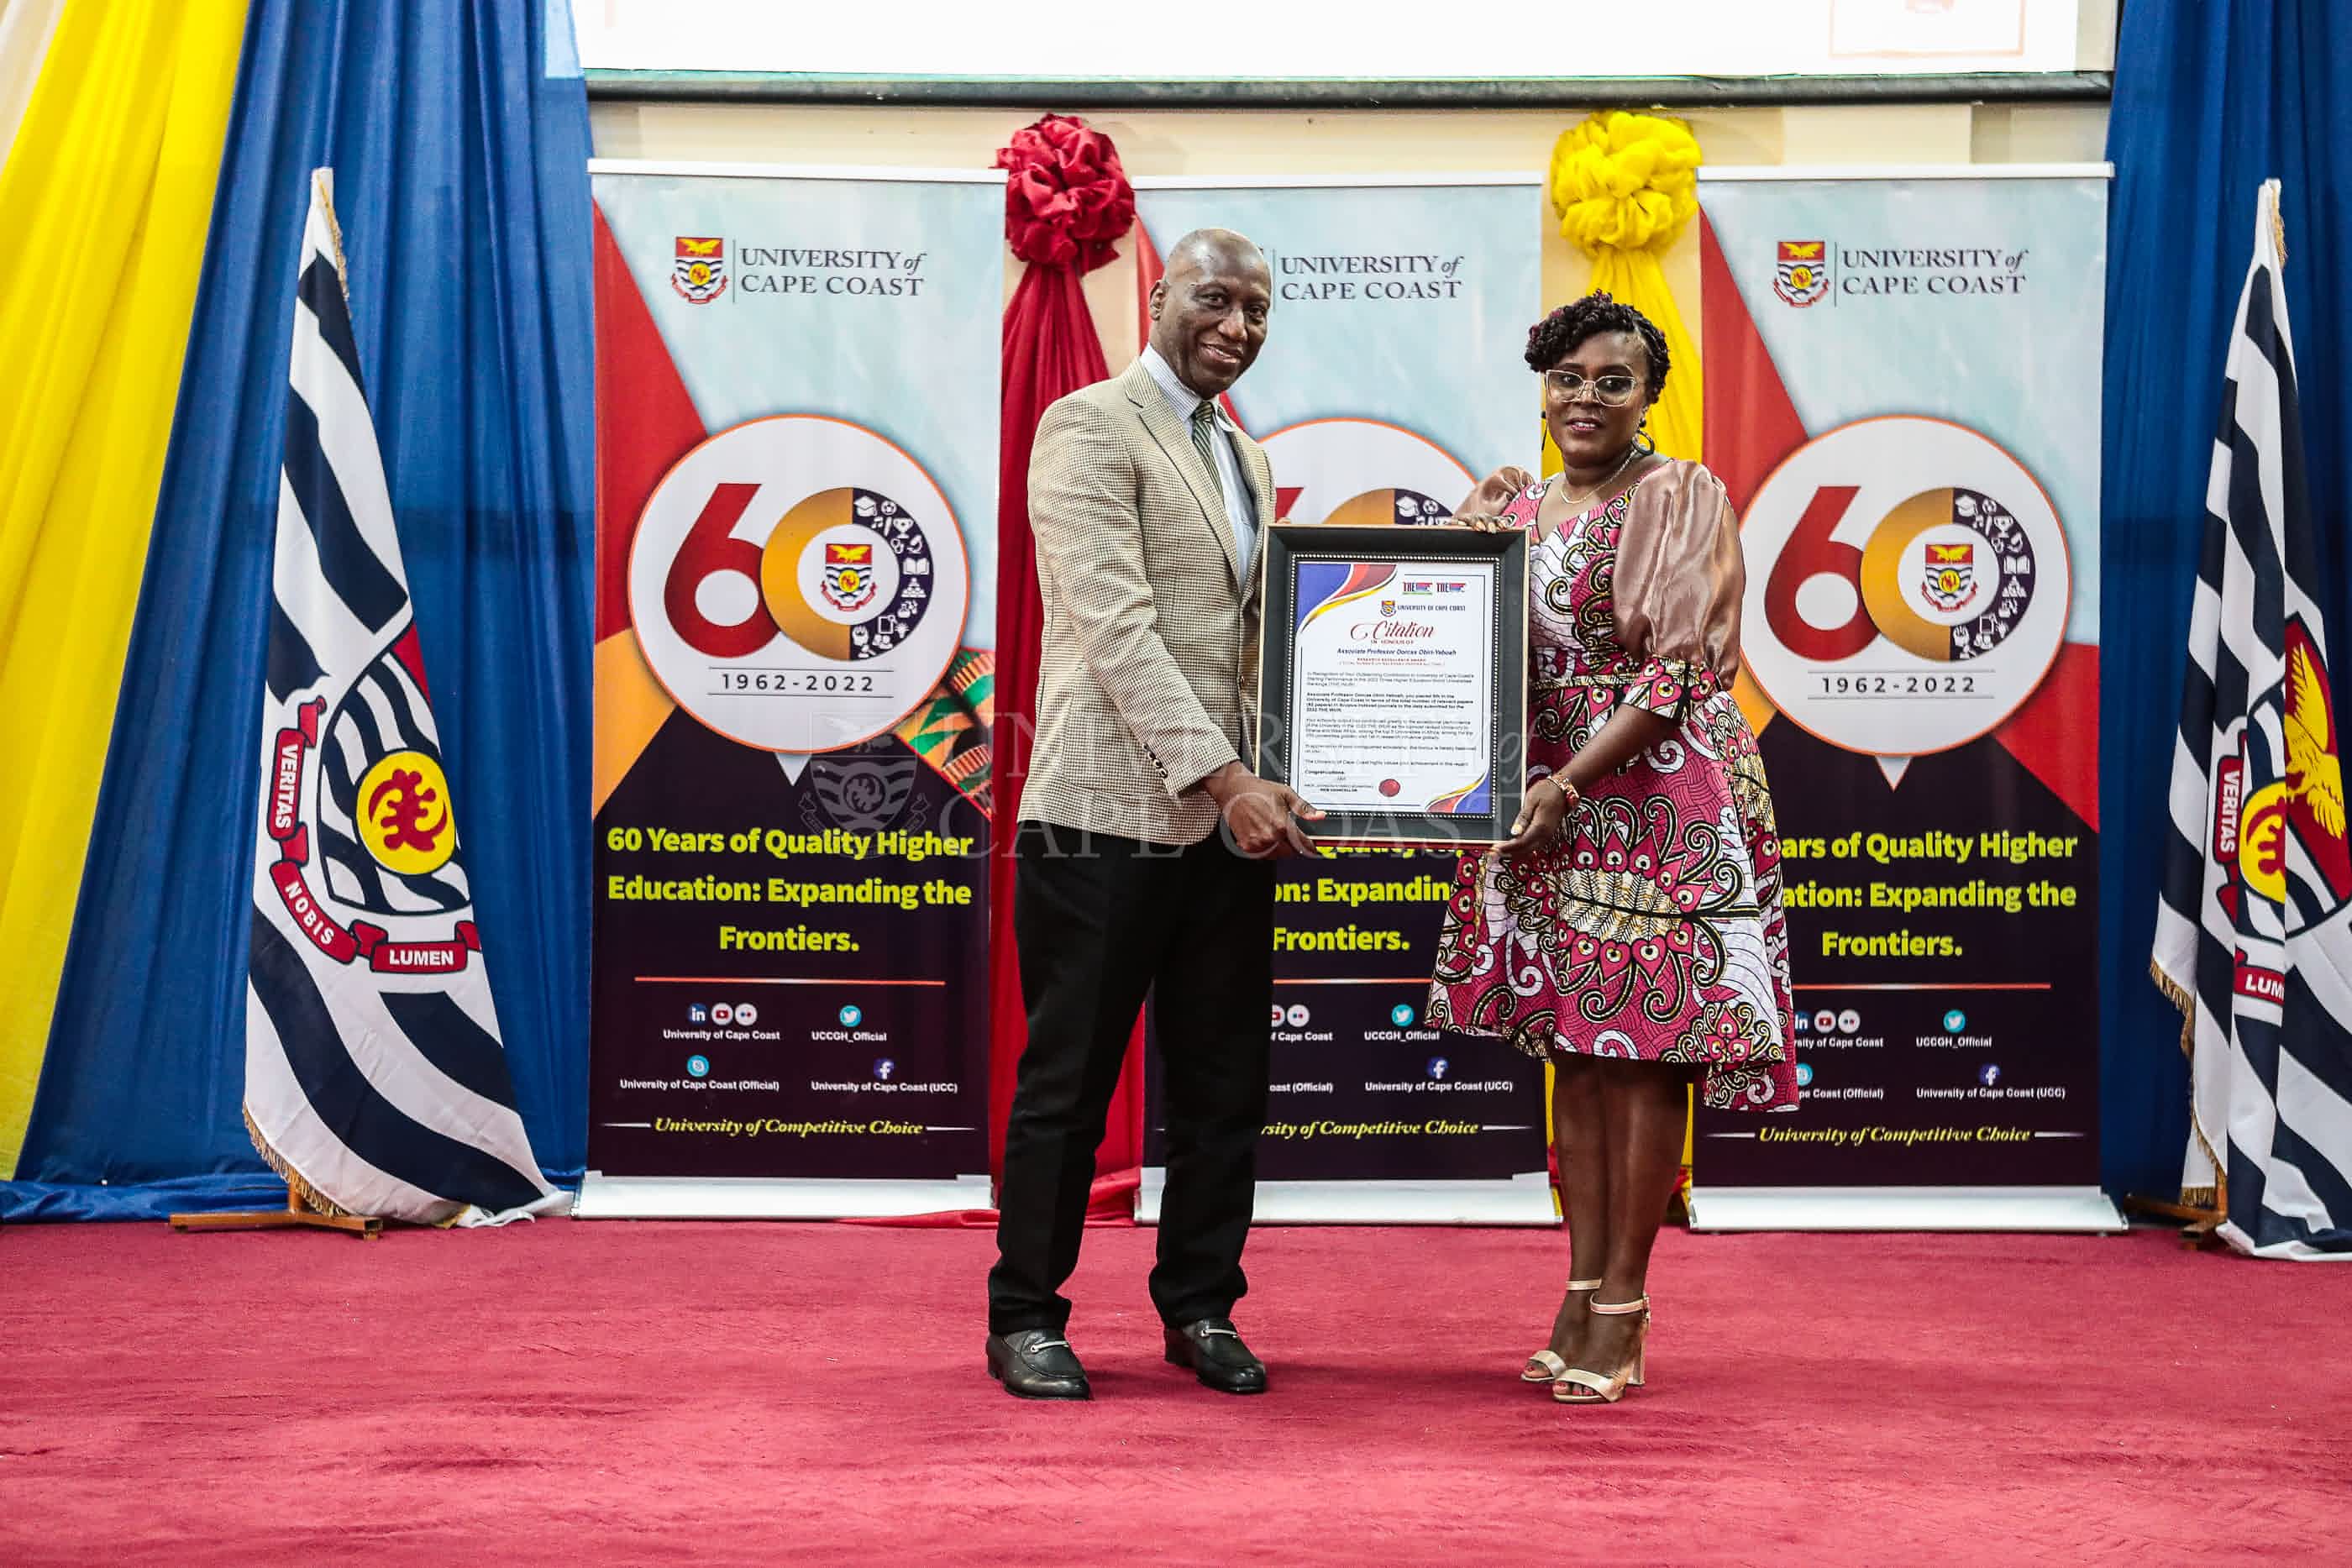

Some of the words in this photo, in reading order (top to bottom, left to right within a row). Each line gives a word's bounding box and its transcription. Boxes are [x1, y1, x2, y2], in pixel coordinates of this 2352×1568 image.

[740, 249, 900, 269] UNIVERSITY
[904, 254, 927, 275] of
[1281, 256, 1438, 275] UNIVERSITY
[1441, 256, 1464, 278] of
[1843, 249, 2001, 268] UNIVERSITY
[2005, 249, 2029, 273] of
[741, 275, 816, 293] CAPE
[827, 277, 924, 296] COAST
[1281, 283, 1356, 300] CAPE
[1365, 281, 1462, 299] COAST
[1843, 276, 1918, 294] CAPE
[1927, 275, 2026, 294] COAST
[664, 483, 934, 661] 60
[1765, 485, 2036, 663] 60
[1351, 620, 1434, 639] Citation
[722, 673, 874, 692] 1962-2022
[1823, 675, 1976, 694] 1962-2022
[276, 744, 299, 829] VERITAS
[2220, 770, 2240, 853] VERITAS
[608, 828, 642, 851] 60
[648, 828, 724, 852] Years
[730, 828, 761, 852] of
[765, 829, 870, 860] Quality
[878, 830, 974, 861] Higher
[1782, 839, 1825, 857] ars
[1832, 832, 1861, 857] of
[1866, 831, 1973, 863] Quality
[1981, 831, 2077, 863] Higher
[609, 875, 760, 901] Education:
[769, 878, 918, 909] Expanding
[923, 880, 971, 904] the
[1317, 876, 1450, 907] Expandin
[1782, 881, 1862, 907] ation:
[1871, 880, 2021, 912] Expanding
[2027, 881, 2076, 906] the
[285, 881, 333, 945] NOBIS
[721, 926, 858, 951] Frontiers.
[1273, 925, 1409, 950] Frontiers.
[1823, 930, 1962, 956] Frontiers.
[389, 949, 454, 966] LUMEN
[2244, 973, 2284, 999] LUM
[664, 1030, 711, 1041] University
[726, 1030, 749, 1041] Cape
[753, 1030, 780, 1039] Coast
[812, 1031, 886, 1042] UCCGH_Official
[1278, 1032, 1302, 1041] Cape
[1305, 1032, 1332, 1041] Coast
[1364, 1031, 1439, 1041] UCCGH_Official
[1794, 1037, 1814, 1049] rsity
[1817, 1038, 1826, 1046] of
[1830, 1038, 1853, 1048] Cape
[1856, 1038, 1882, 1046] Coast
[1916, 1037, 1992, 1046] UCCGH_Official
[620, 1080, 668, 1090] University
[670, 1080, 680, 1088] of
[682, 1080, 706, 1090] Cape
[709, 1080, 737, 1088] Coast
[739, 1081, 779, 1091] (Official)
[811, 1082, 858, 1092] University
[873, 1083, 897, 1093] Cape
[900, 1083, 927, 1091] Coast
[930, 1083, 957, 1093] (UCC)
[1293, 1083, 1332, 1093] (Official)
[1366, 1083, 1413, 1093] University
[1415, 1082, 1425, 1090] of
[1428, 1082, 1452, 1092] Cape
[1455, 1082, 1482, 1090] Coast
[1484, 1082, 1512, 1092] (UCC)
[1798, 1089, 1811, 1100] pe
[1814, 1088, 1840, 1098] Coast
[1844, 1088, 1883, 1099] (Official)
[1917, 1088, 1964, 1099] University
[1967, 1088, 1977, 1097] of
[1980, 1088, 2003, 1099] Cape
[2007, 1088, 2034, 1097] Coast
[2037, 1088, 2065, 1099] (UCC)
[656, 1119, 743, 1135] University
[746, 1120, 765, 1136] of
[762, 1120, 865, 1137] Competitive
[870, 1120, 922, 1134] Choice
[1262, 1122, 1297, 1139] rsity
[1300, 1122, 1320, 1139] of
[1320, 1122, 1420, 1139] Competitive
[1425, 1120, 1478, 1133] Choice
[1761, 1128, 1846, 1146] University
[1851, 1129, 1870, 1146] of
[1871, 1128, 1971, 1146] Competitive
[1977, 1127, 2029, 1141] Choice
